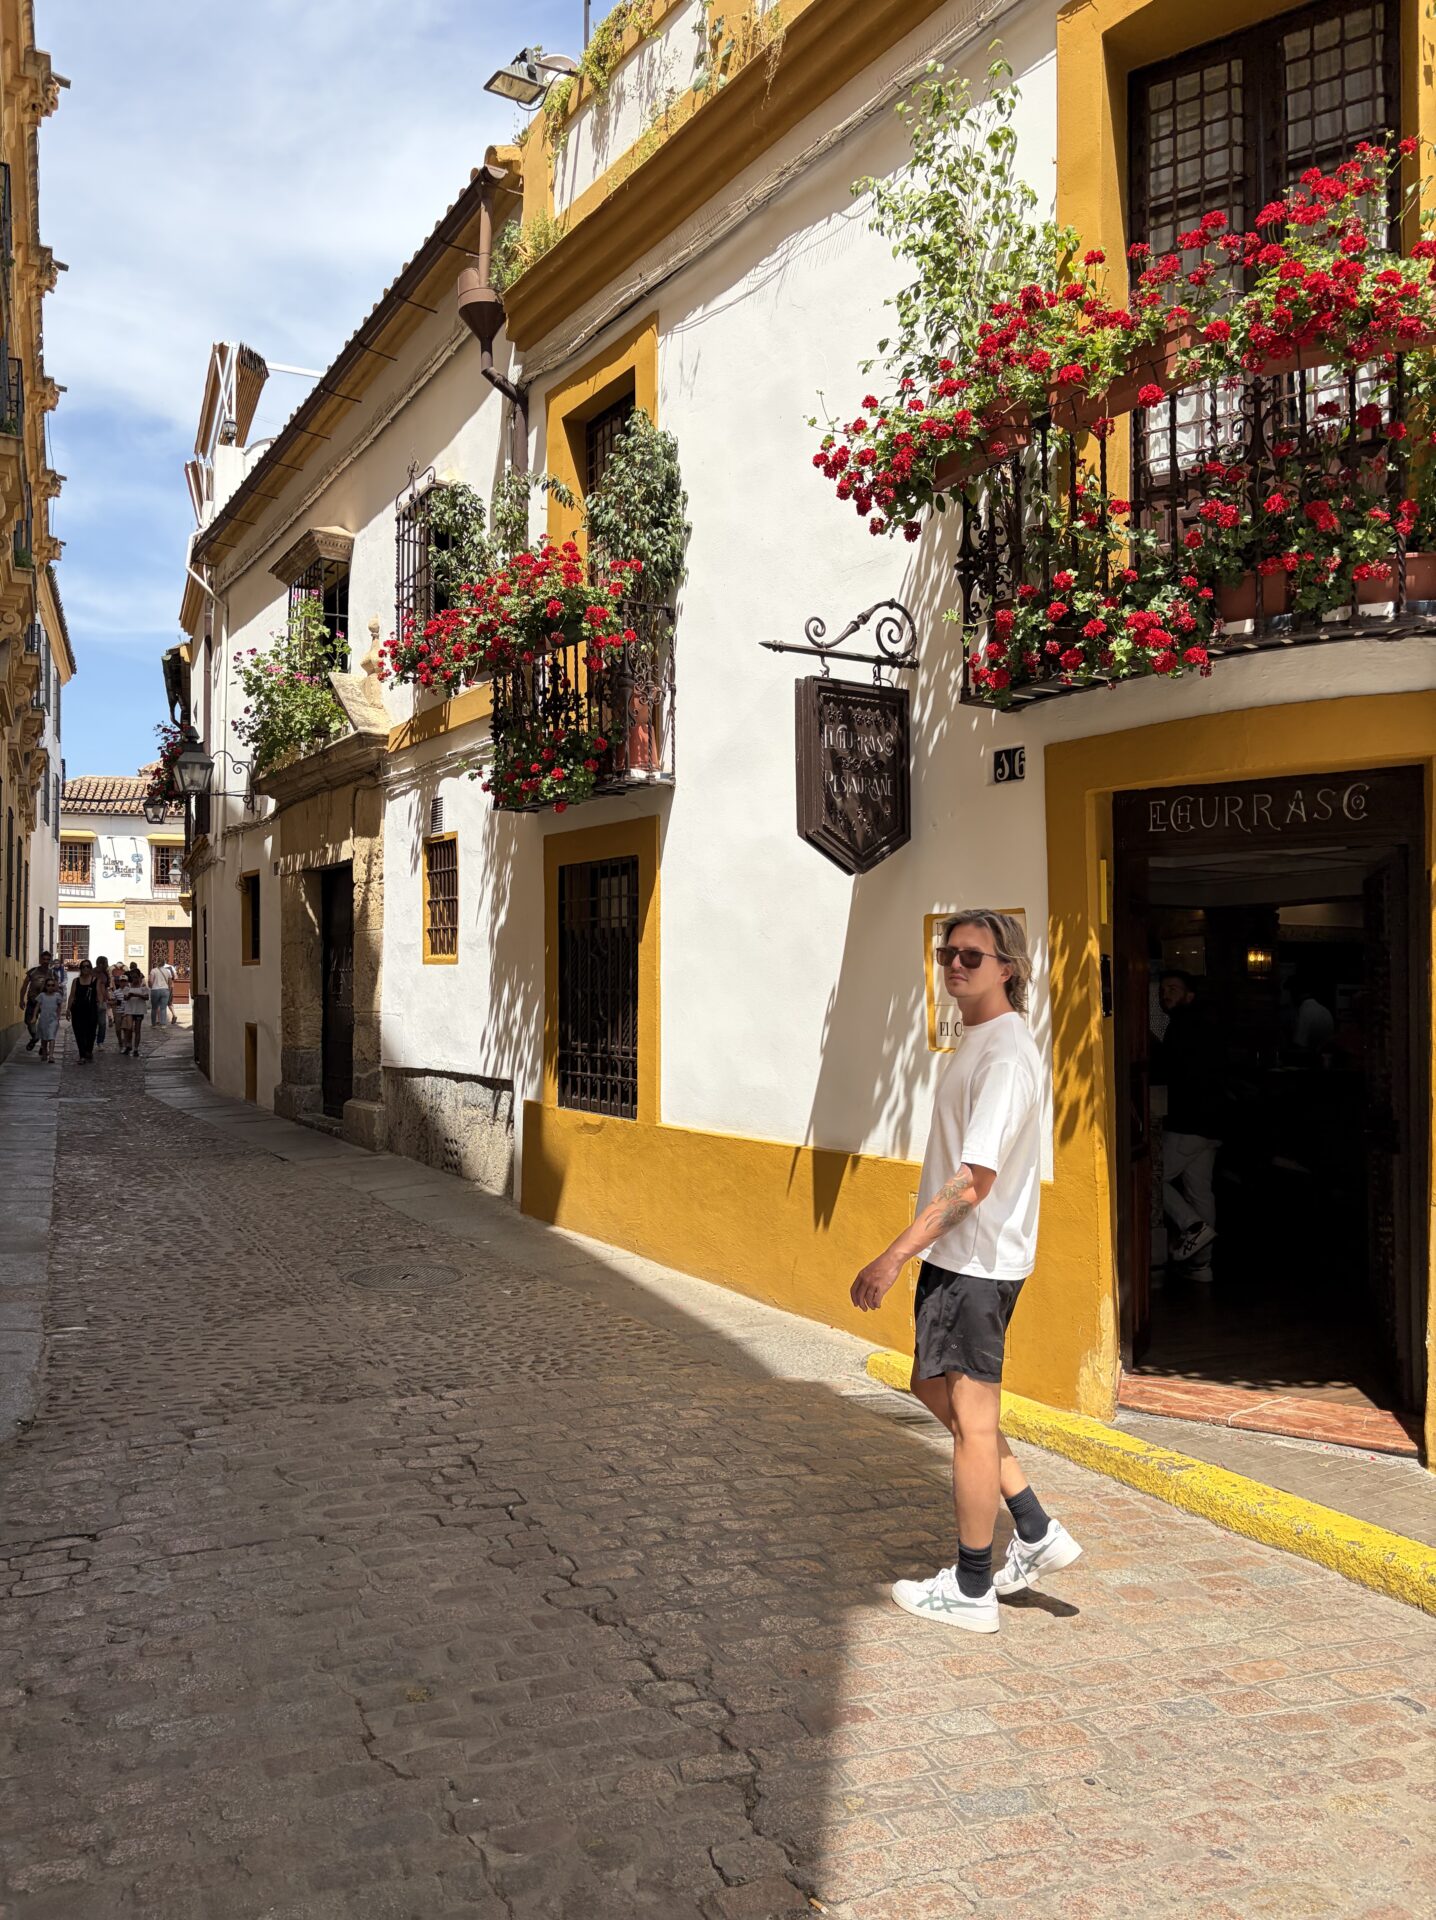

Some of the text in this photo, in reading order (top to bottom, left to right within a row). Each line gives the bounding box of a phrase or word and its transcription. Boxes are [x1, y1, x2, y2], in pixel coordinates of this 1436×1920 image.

[996, 749, 1026, 781] 16
[824, 769, 893, 801] RESTAURANTE
[1148, 783, 1370, 833] EL CHURRASCO
